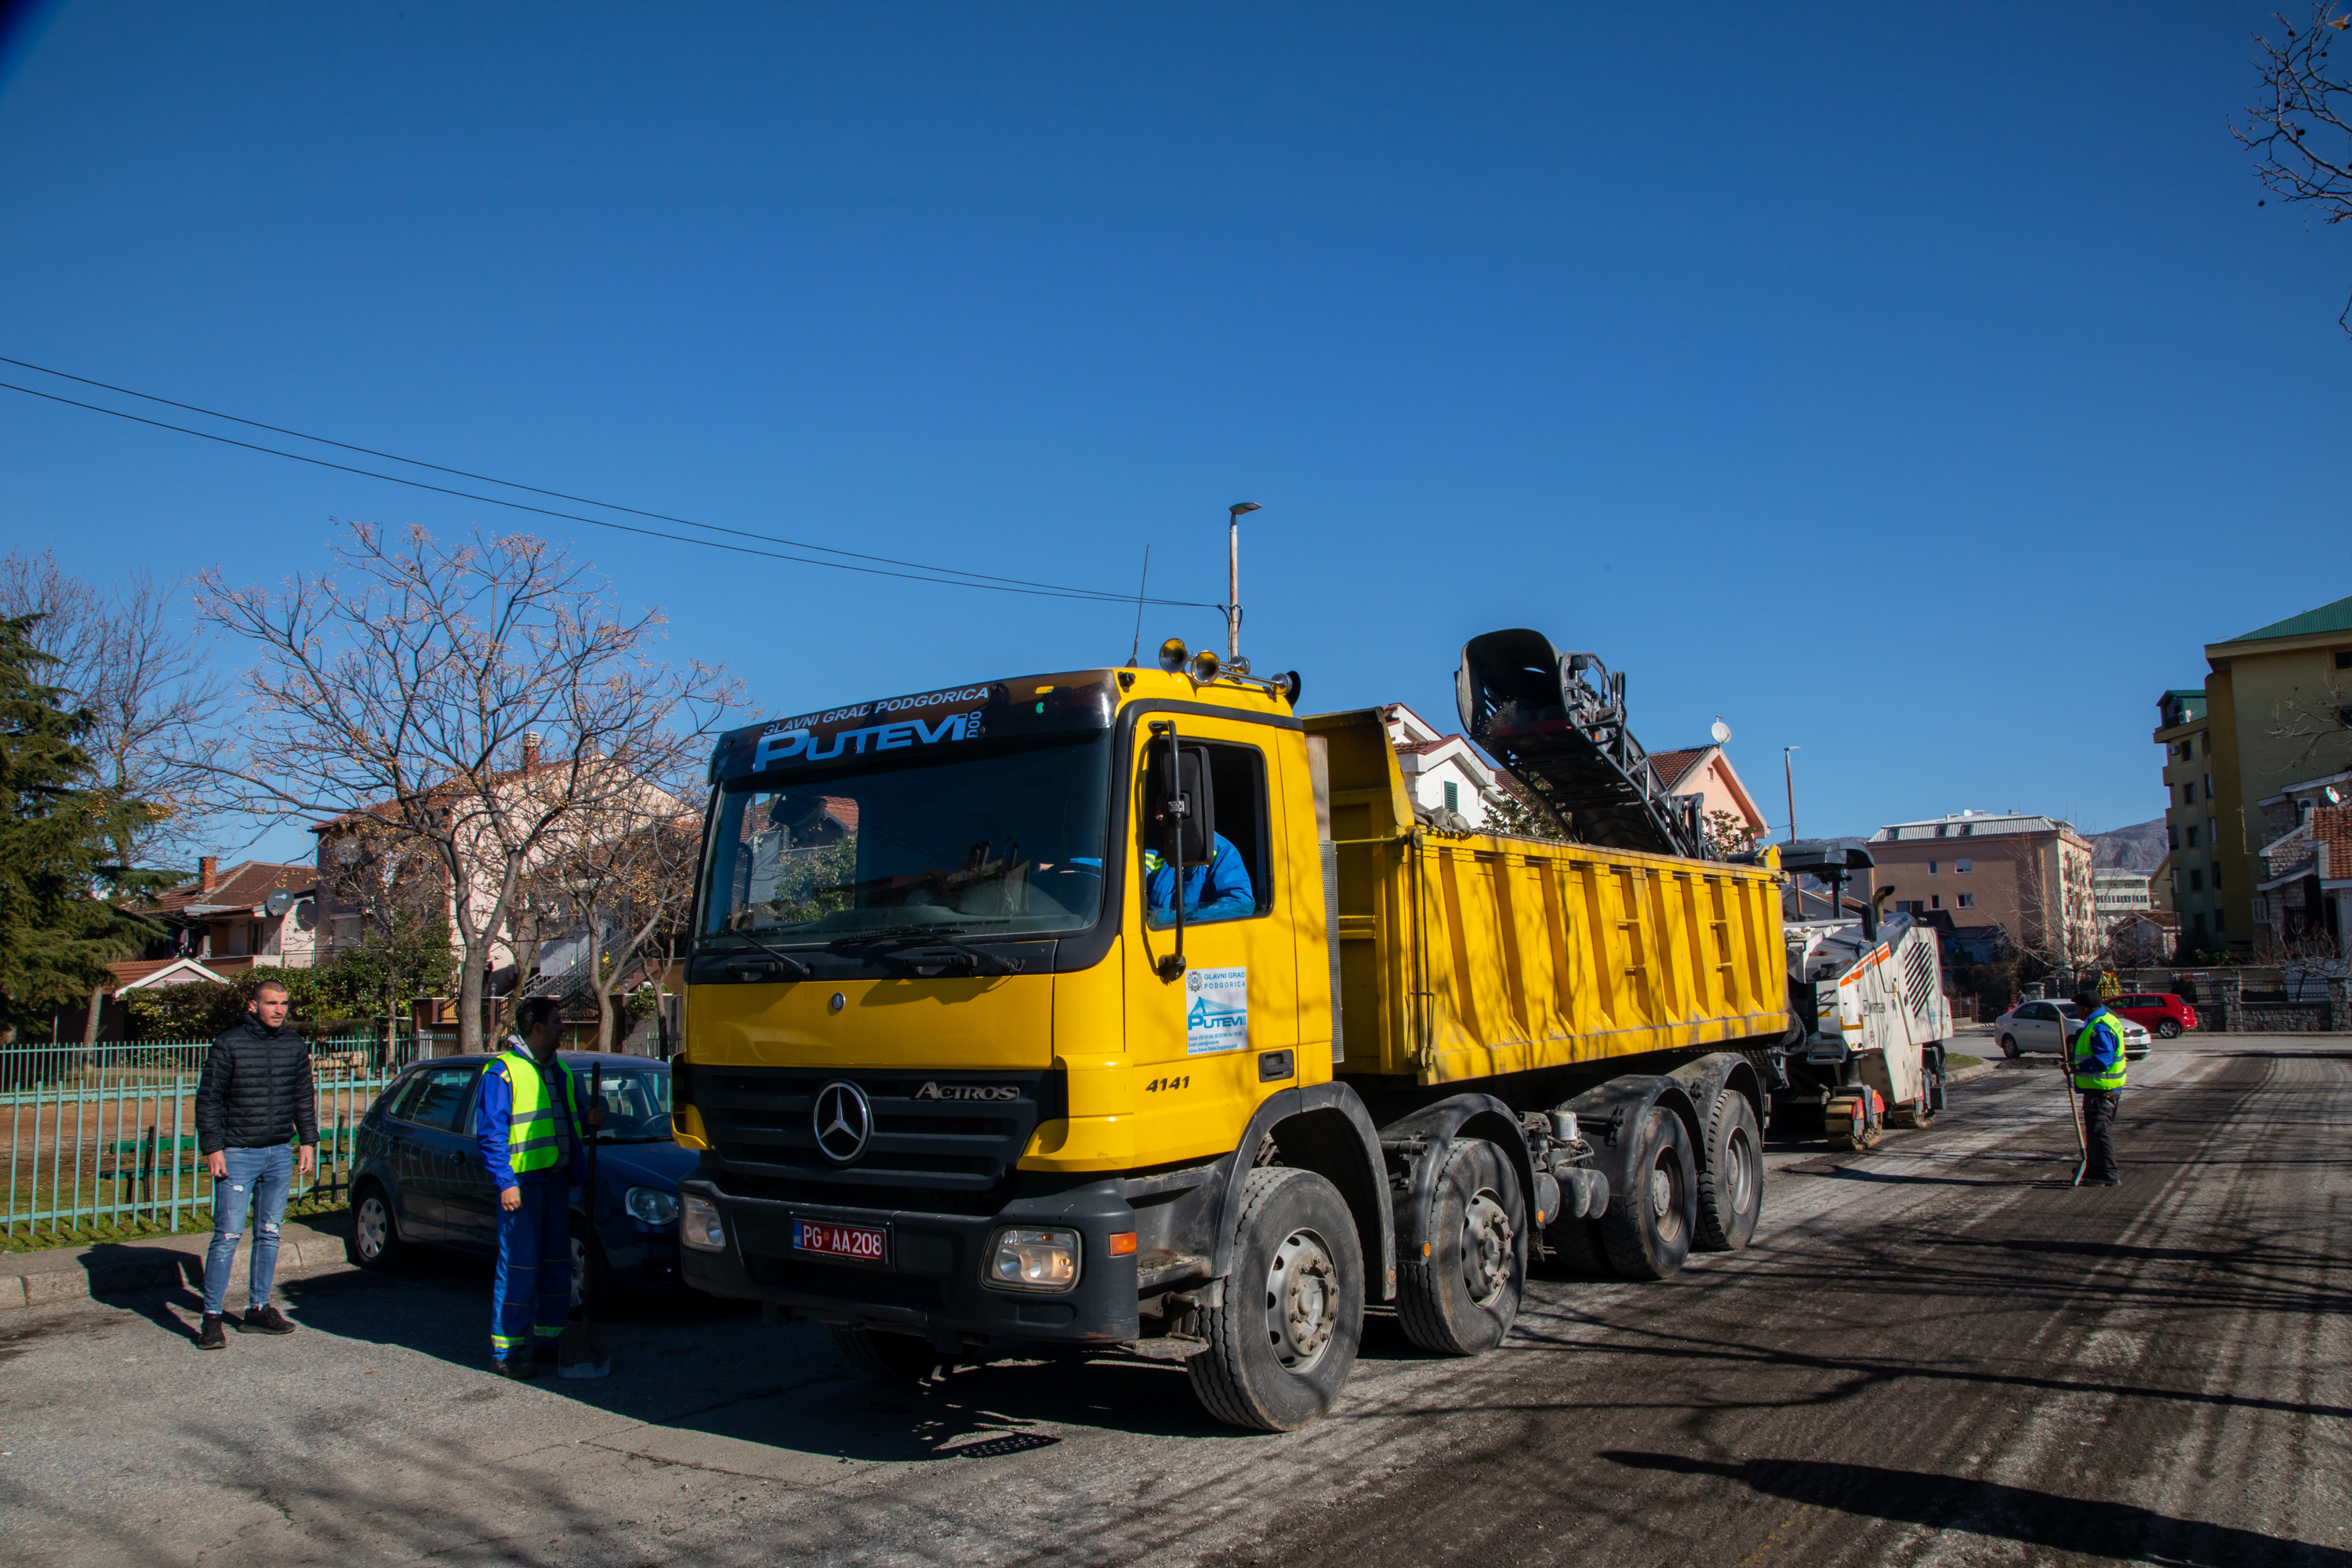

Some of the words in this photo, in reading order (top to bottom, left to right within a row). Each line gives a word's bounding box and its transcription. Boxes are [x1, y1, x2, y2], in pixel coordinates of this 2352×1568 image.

[764, 714, 819, 735] GLAVNI
[823, 704, 870, 724] GRAD
[875, 687, 989, 713] PODGORICA
[966, 710, 982, 738] DOO
[753, 713, 969, 772] PUTEVI
[1204, 981, 1246, 989] PODGORICA
[1188, 1014, 1243, 1030] PUTEVI
[1145, 1076, 1189, 1092] 4141
[804, 1225, 822, 1247] PG
[832, 1229, 882, 1255] AA208
